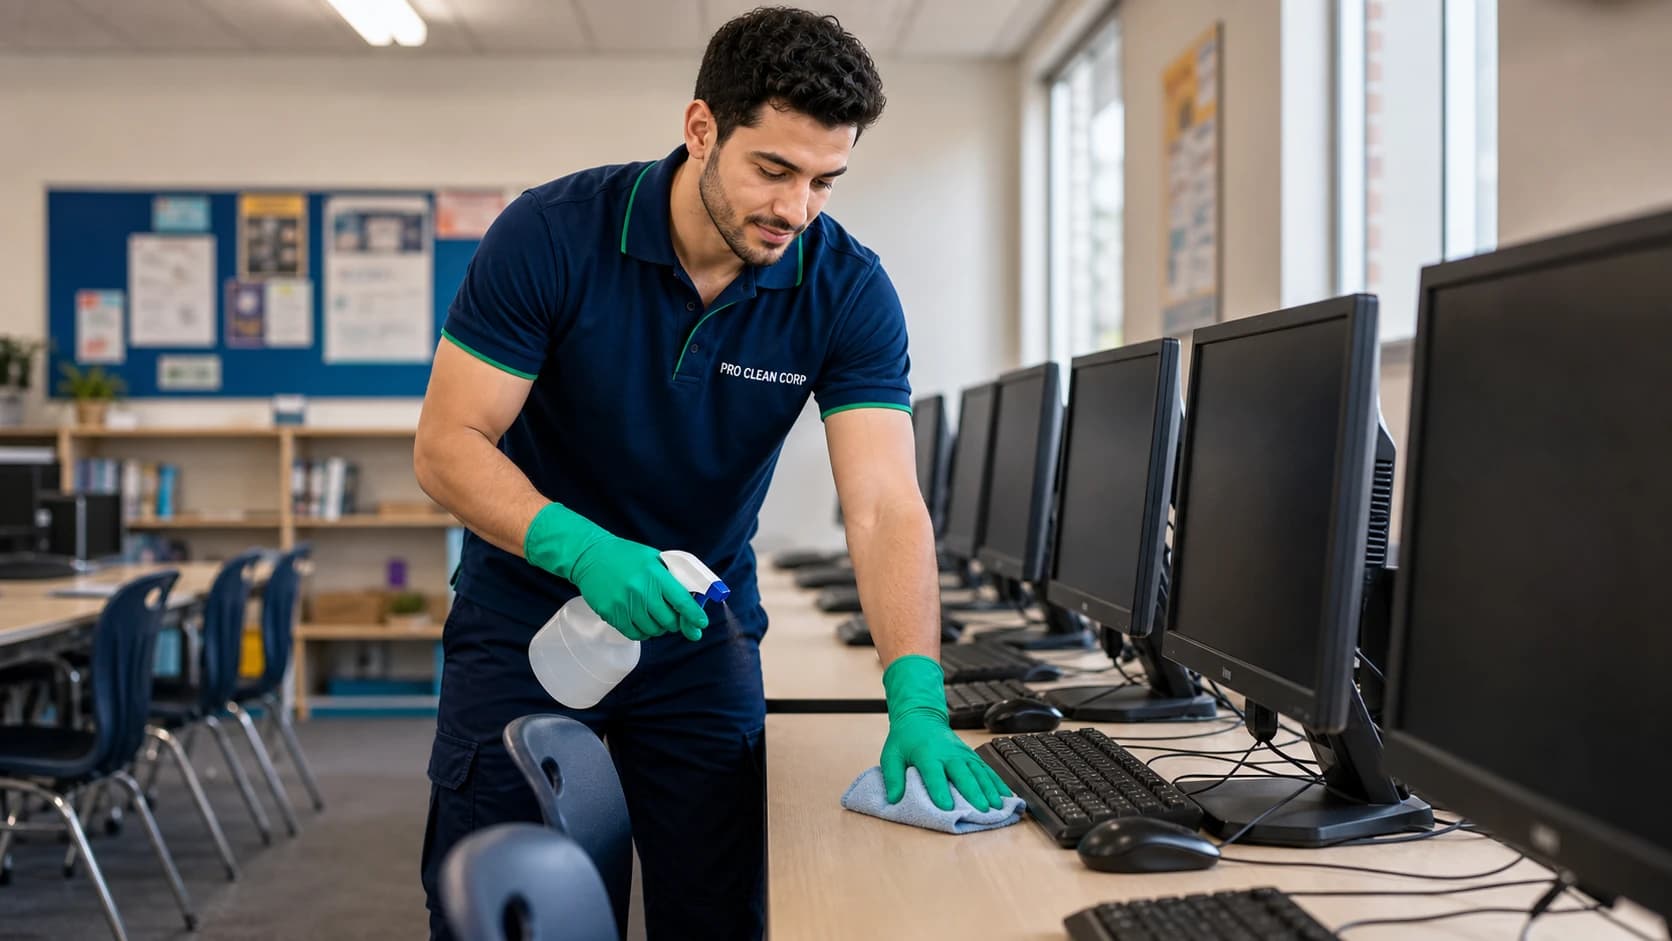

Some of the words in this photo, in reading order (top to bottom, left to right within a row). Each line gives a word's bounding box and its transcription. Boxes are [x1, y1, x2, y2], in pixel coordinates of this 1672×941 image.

[720, 362, 741, 377] PRO
[743, 367, 777, 383] CLEAN
[779, 372, 807, 385] CORP
